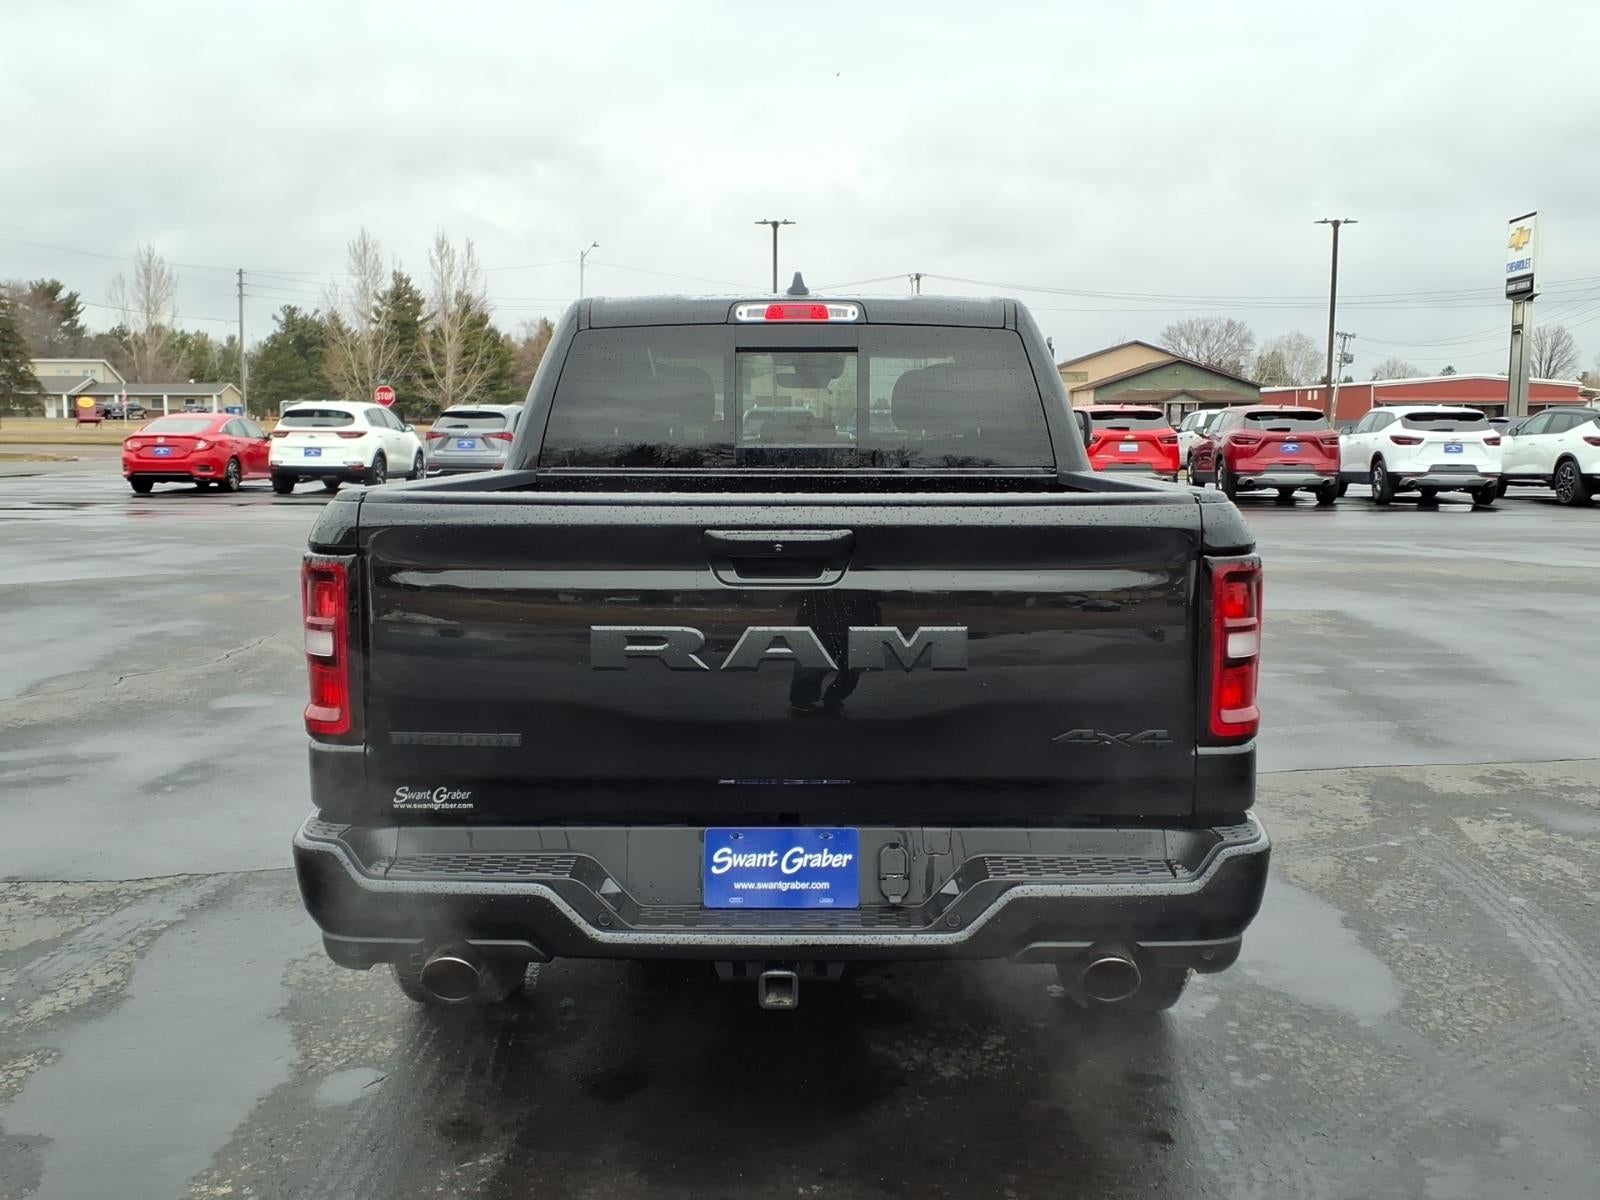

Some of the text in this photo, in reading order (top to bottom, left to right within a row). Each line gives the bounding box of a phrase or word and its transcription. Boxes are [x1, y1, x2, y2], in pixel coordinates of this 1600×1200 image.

[1506, 257, 1531, 273] CHEVROLET
[375, 391, 393, 400] STOP
[590, 625, 969, 671] RAM
[393, 786, 471, 803] Swant Graber
[711, 846, 853, 874] Swant Graber
[733, 880, 830, 891] www.swantgraber.com
